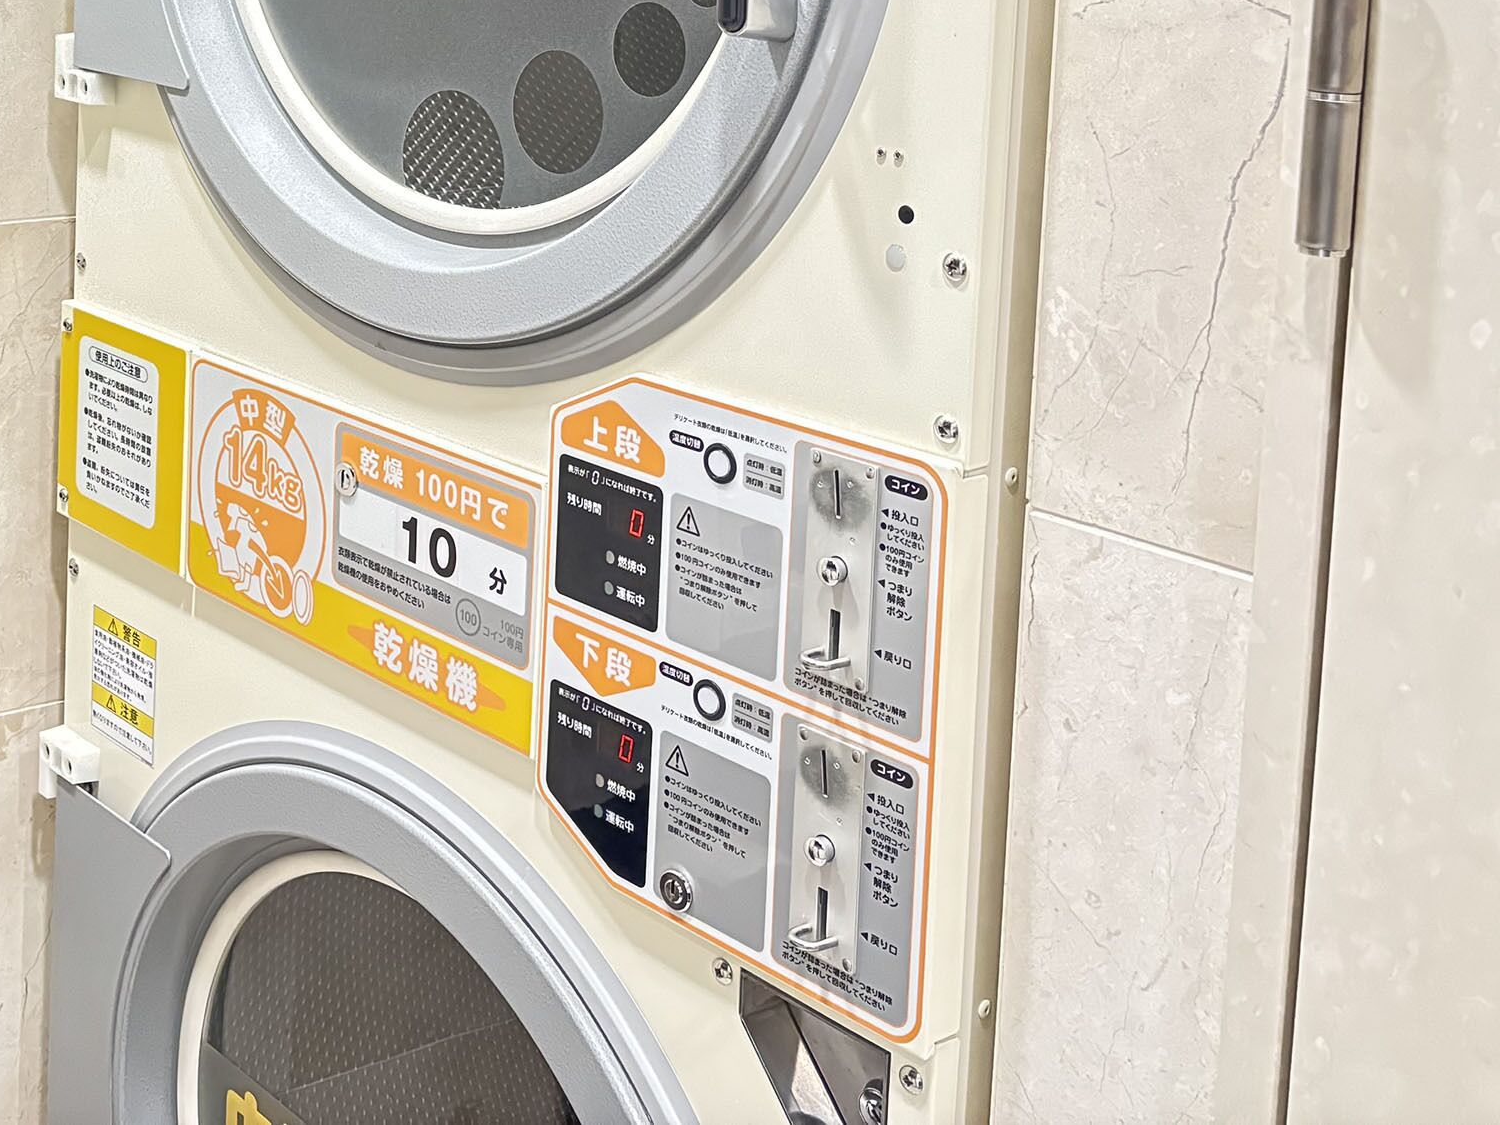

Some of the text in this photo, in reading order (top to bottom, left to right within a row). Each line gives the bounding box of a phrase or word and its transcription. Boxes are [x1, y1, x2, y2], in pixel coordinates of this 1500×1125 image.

[95, 350, 141, 379] 使用上のご注意
[240, 394, 286, 440] 中型
[583, 415, 642, 463] 上段
[223, 424, 303, 513] 14kg
[359, 446, 508, 530] 乾燥 100円で
[891, 478, 920, 496] コイン
[566, 492, 602, 516] 残り時間
[629, 508, 645, 538] 0
[891, 508, 919, 527] 投入口
[647, 534, 655, 545] 分
[886, 532, 925, 552] してください
[887, 523, 925, 543] ゆっくり投入
[402, 516, 508, 594] 10 分
[617, 554, 647, 576] 燃焼中
[885, 554, 913, 571] のみ使用
[886, 544, 925, 564] 100円コイン
[884, 563, 911, 578] できます
[616, 585, 646, 608] 運転中
[888, 579, 913, 597] つまり
[886, 592, 906, 608] 解除
[886, 605, 913, 622] ボタン
[123, 624, 141, 648] 警告
[483, 625, 523, 653] コイン専用
[500, 619, 524, 639] 100円
[372, 622, 478, 712] 乾燥機
[575, 633, 632, 687] 下段
[883, 650, 912, 671] 戻り口
[120, 702, 138, 725] 注意
[557, 711, 592, 739] 残り時間
[618, 734, 635, 763] 0
[637, 762, 645, 773] 分
[877, 762, 906, 782] コイン
[606, 779, 636, 802] 燃焼中
[877, 794, 905, 814] 投入口
[605, 809, 635, 834] 運転中
[872, 818, 910, 840] してください
[873, 808, 910, 832] ゆっくり投入
[871, 839, 899, 858] のみ使用
[872, 829, 910, 852] 100円コイン
[871, 848, 896, 864] できます
[874, 865, 899, 883] つまり
[872, 878, 892, 894] 解除
[872, 890, 899, 908] ボタン
[870, 933, 898, 956] 戻り口
